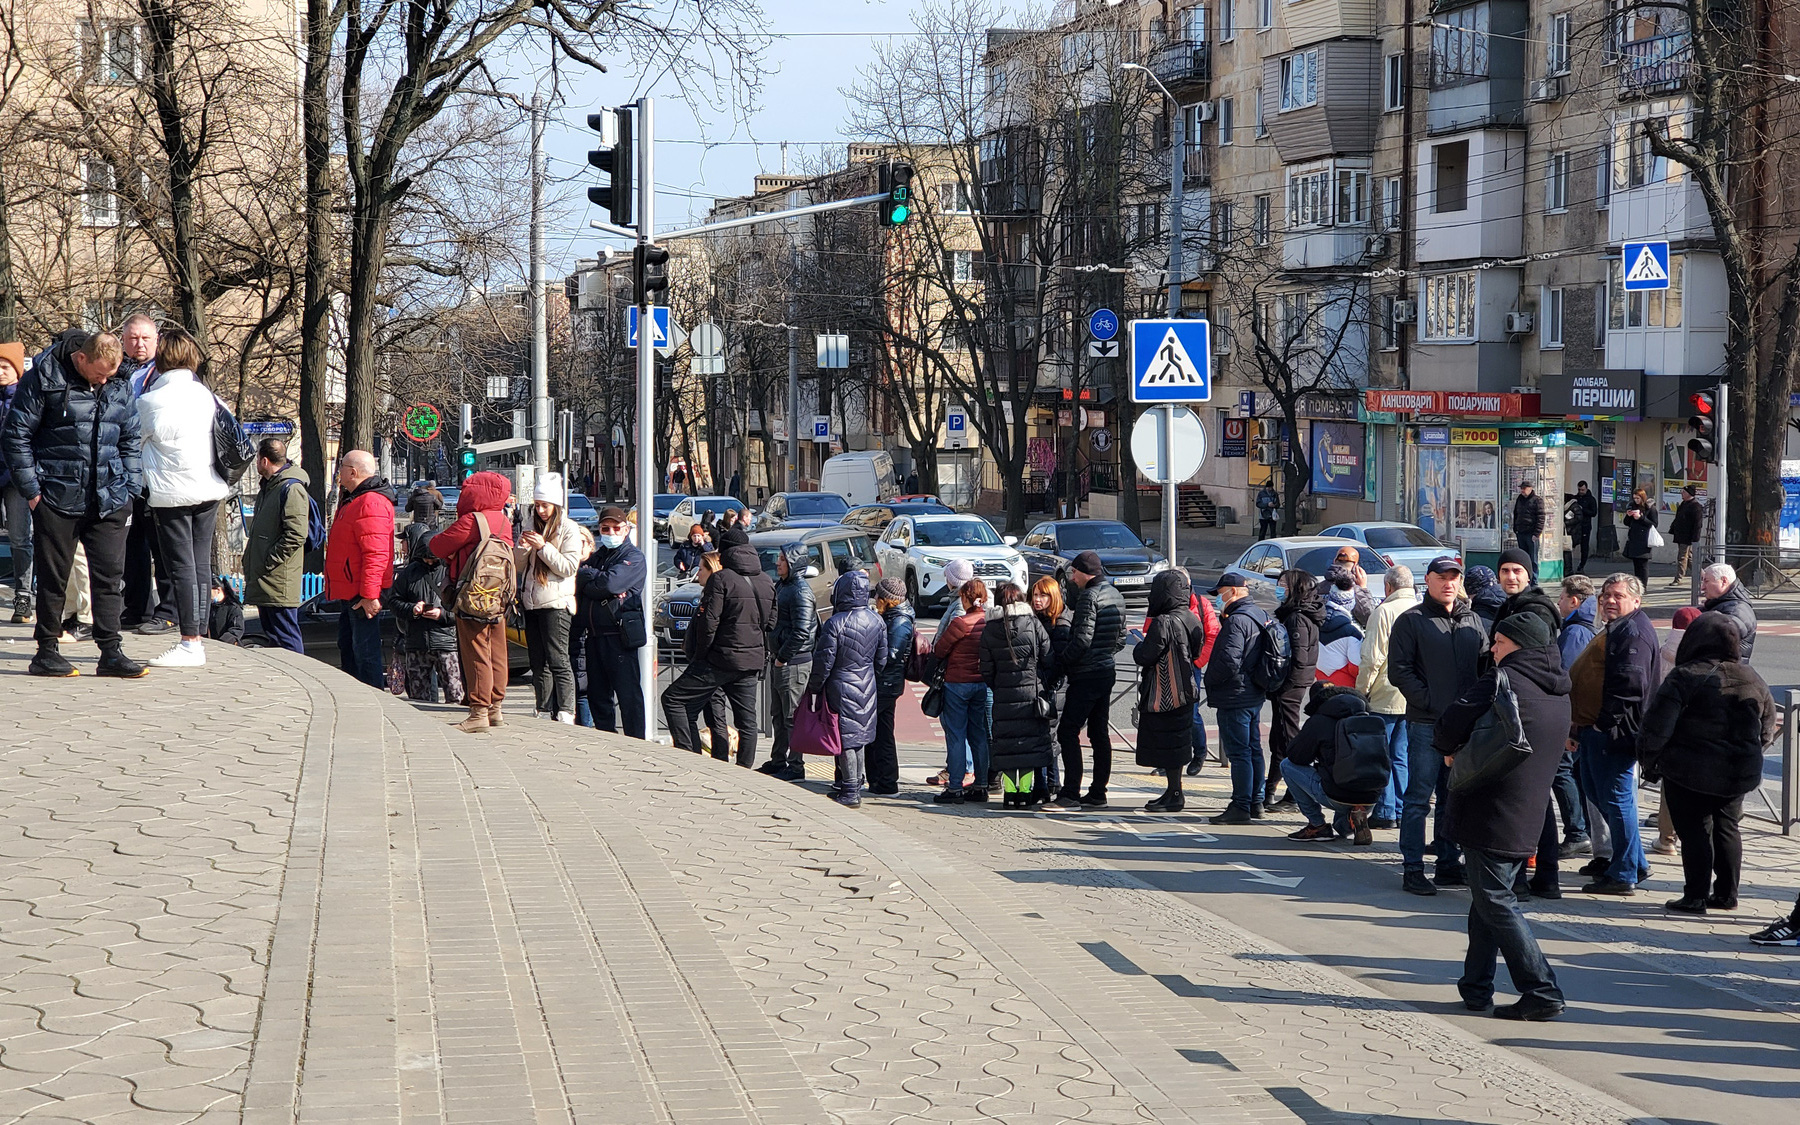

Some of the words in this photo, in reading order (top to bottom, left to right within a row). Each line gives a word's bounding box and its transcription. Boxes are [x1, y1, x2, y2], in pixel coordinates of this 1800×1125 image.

[894, 187, 907, 200] 20
[1573, 377, 1609, 387] ЛОМБАРД
[1381, 394, 1432, 409] КАНЦТОВАРИ
[1448, 396, 1500, 412] ПОДАРУНКИ
[953, 416, 961, 429] P
[819, 424, 826, 434] P
[1514, 430, 1541, 438] INDIGO
[1464, 431, 1498, 441] 7000
[464, 453, 475, 464] 15
